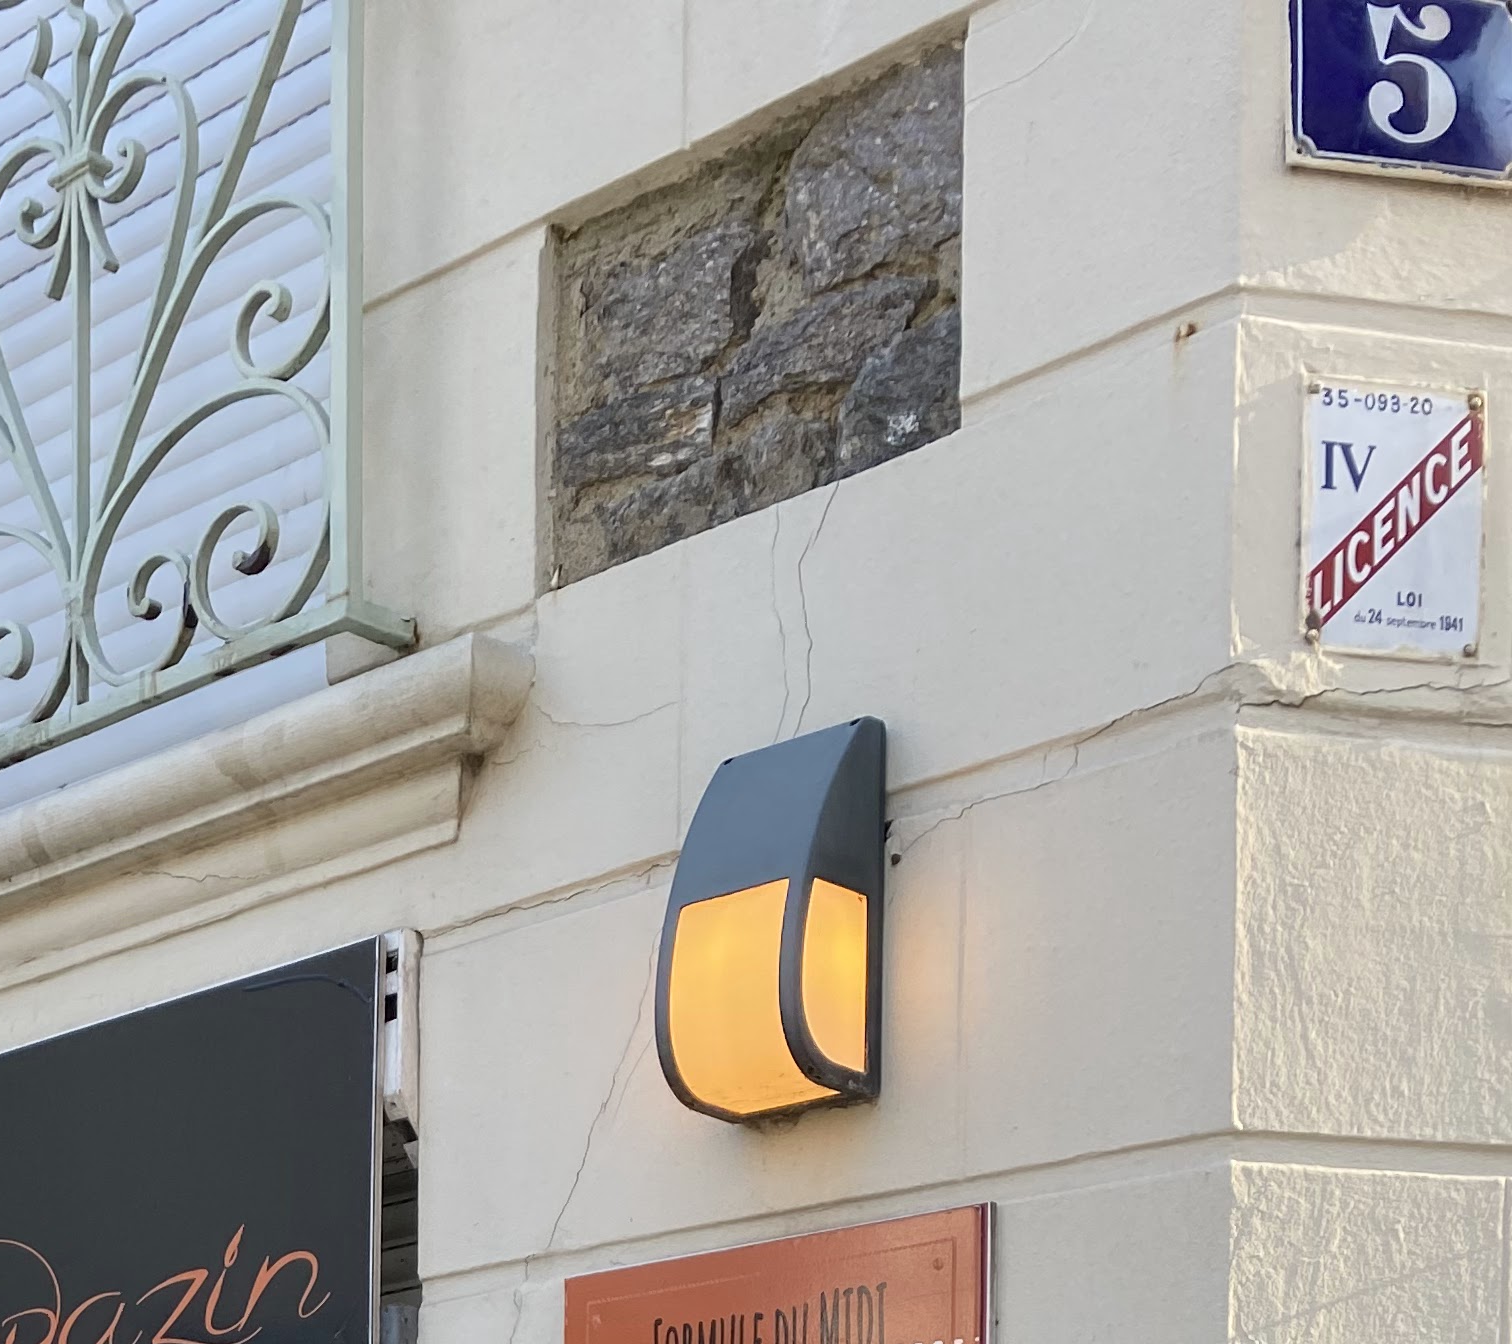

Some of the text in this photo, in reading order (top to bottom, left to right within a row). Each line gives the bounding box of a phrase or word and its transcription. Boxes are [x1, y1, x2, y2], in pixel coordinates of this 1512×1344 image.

[1365, 3, 1457, 144] 5
[1321, 388, 1433, 415] 35-093-20
[1321, 440, 1376, 492] IV
[1313, 419, 1472, 618] LICENCE
[1354, 611, 1366, 624] du
[1368, 610, 1382, 624] 24
[1397, 592, 1423, 608] LOI
